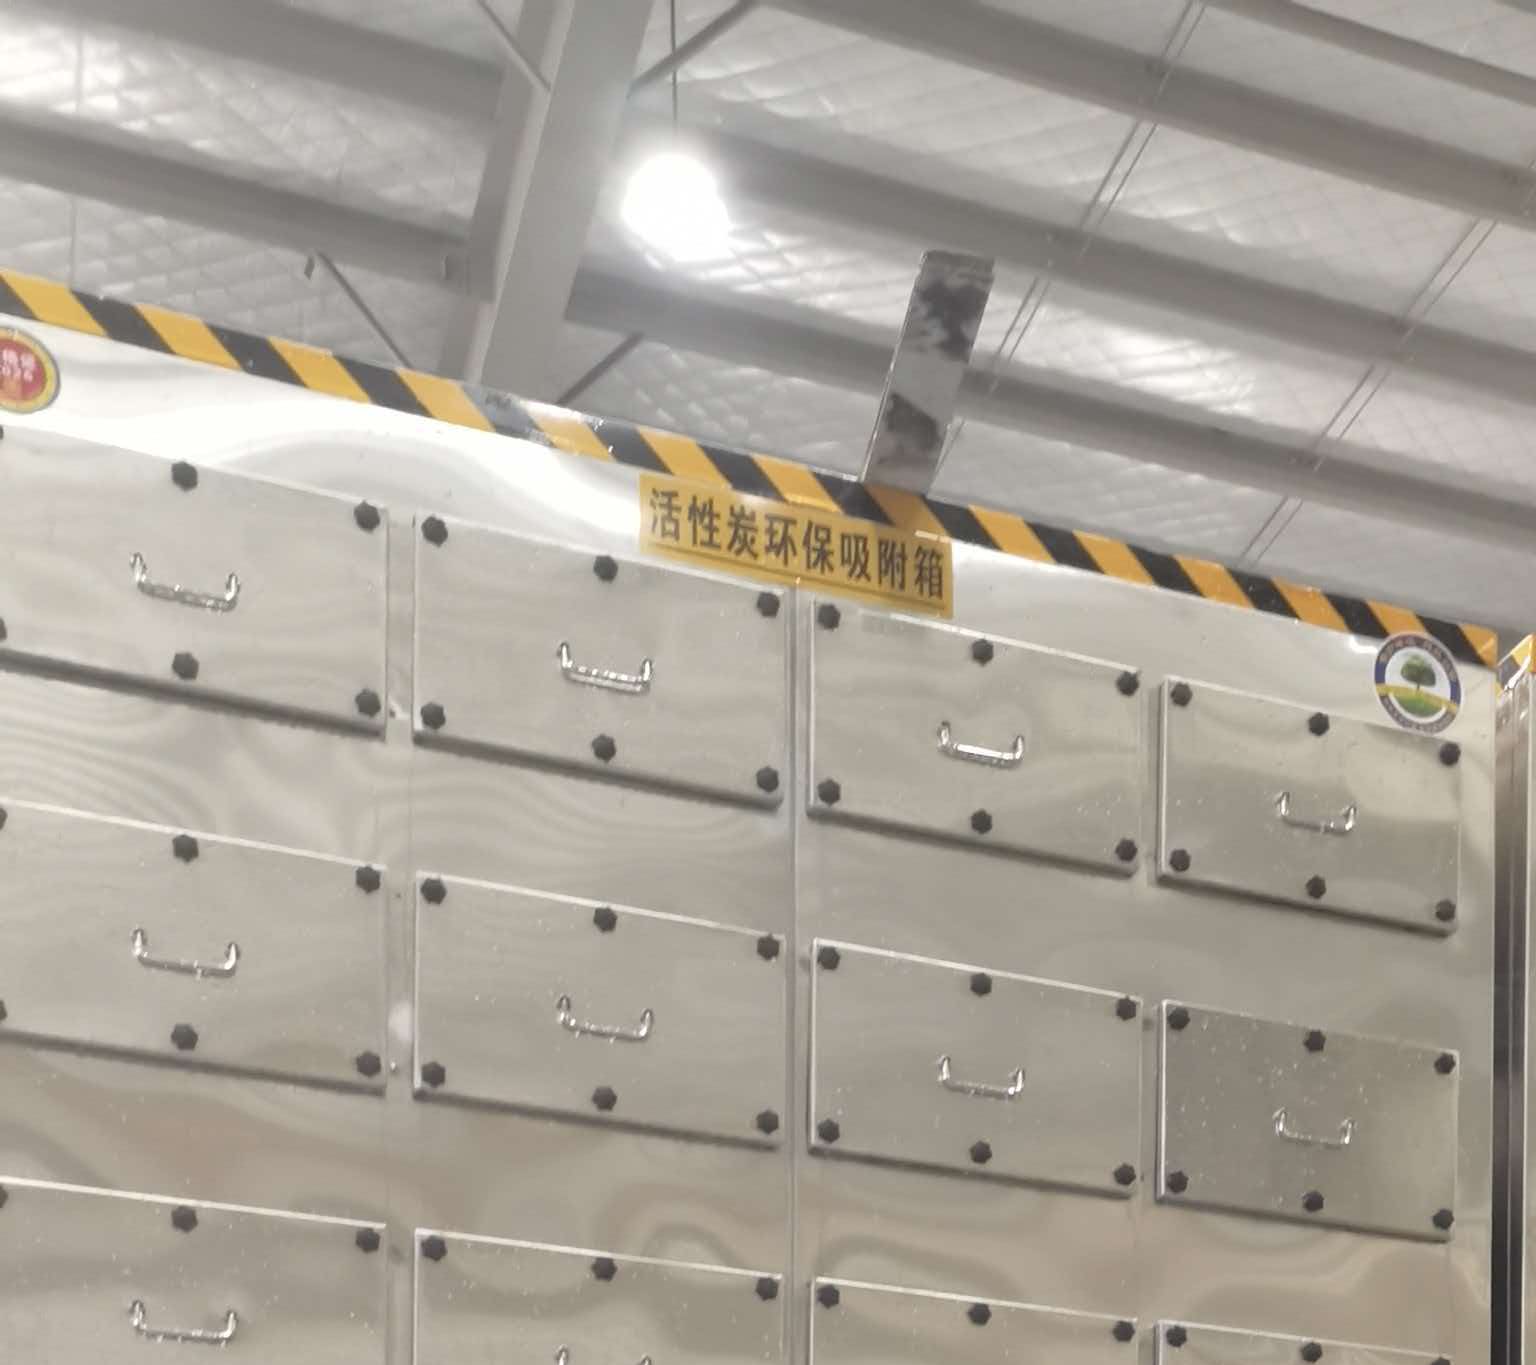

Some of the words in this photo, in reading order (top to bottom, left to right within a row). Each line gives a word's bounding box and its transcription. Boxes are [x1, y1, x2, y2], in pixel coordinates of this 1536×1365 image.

[650, 487, 944, 600] 活性炭环保吸附箱
